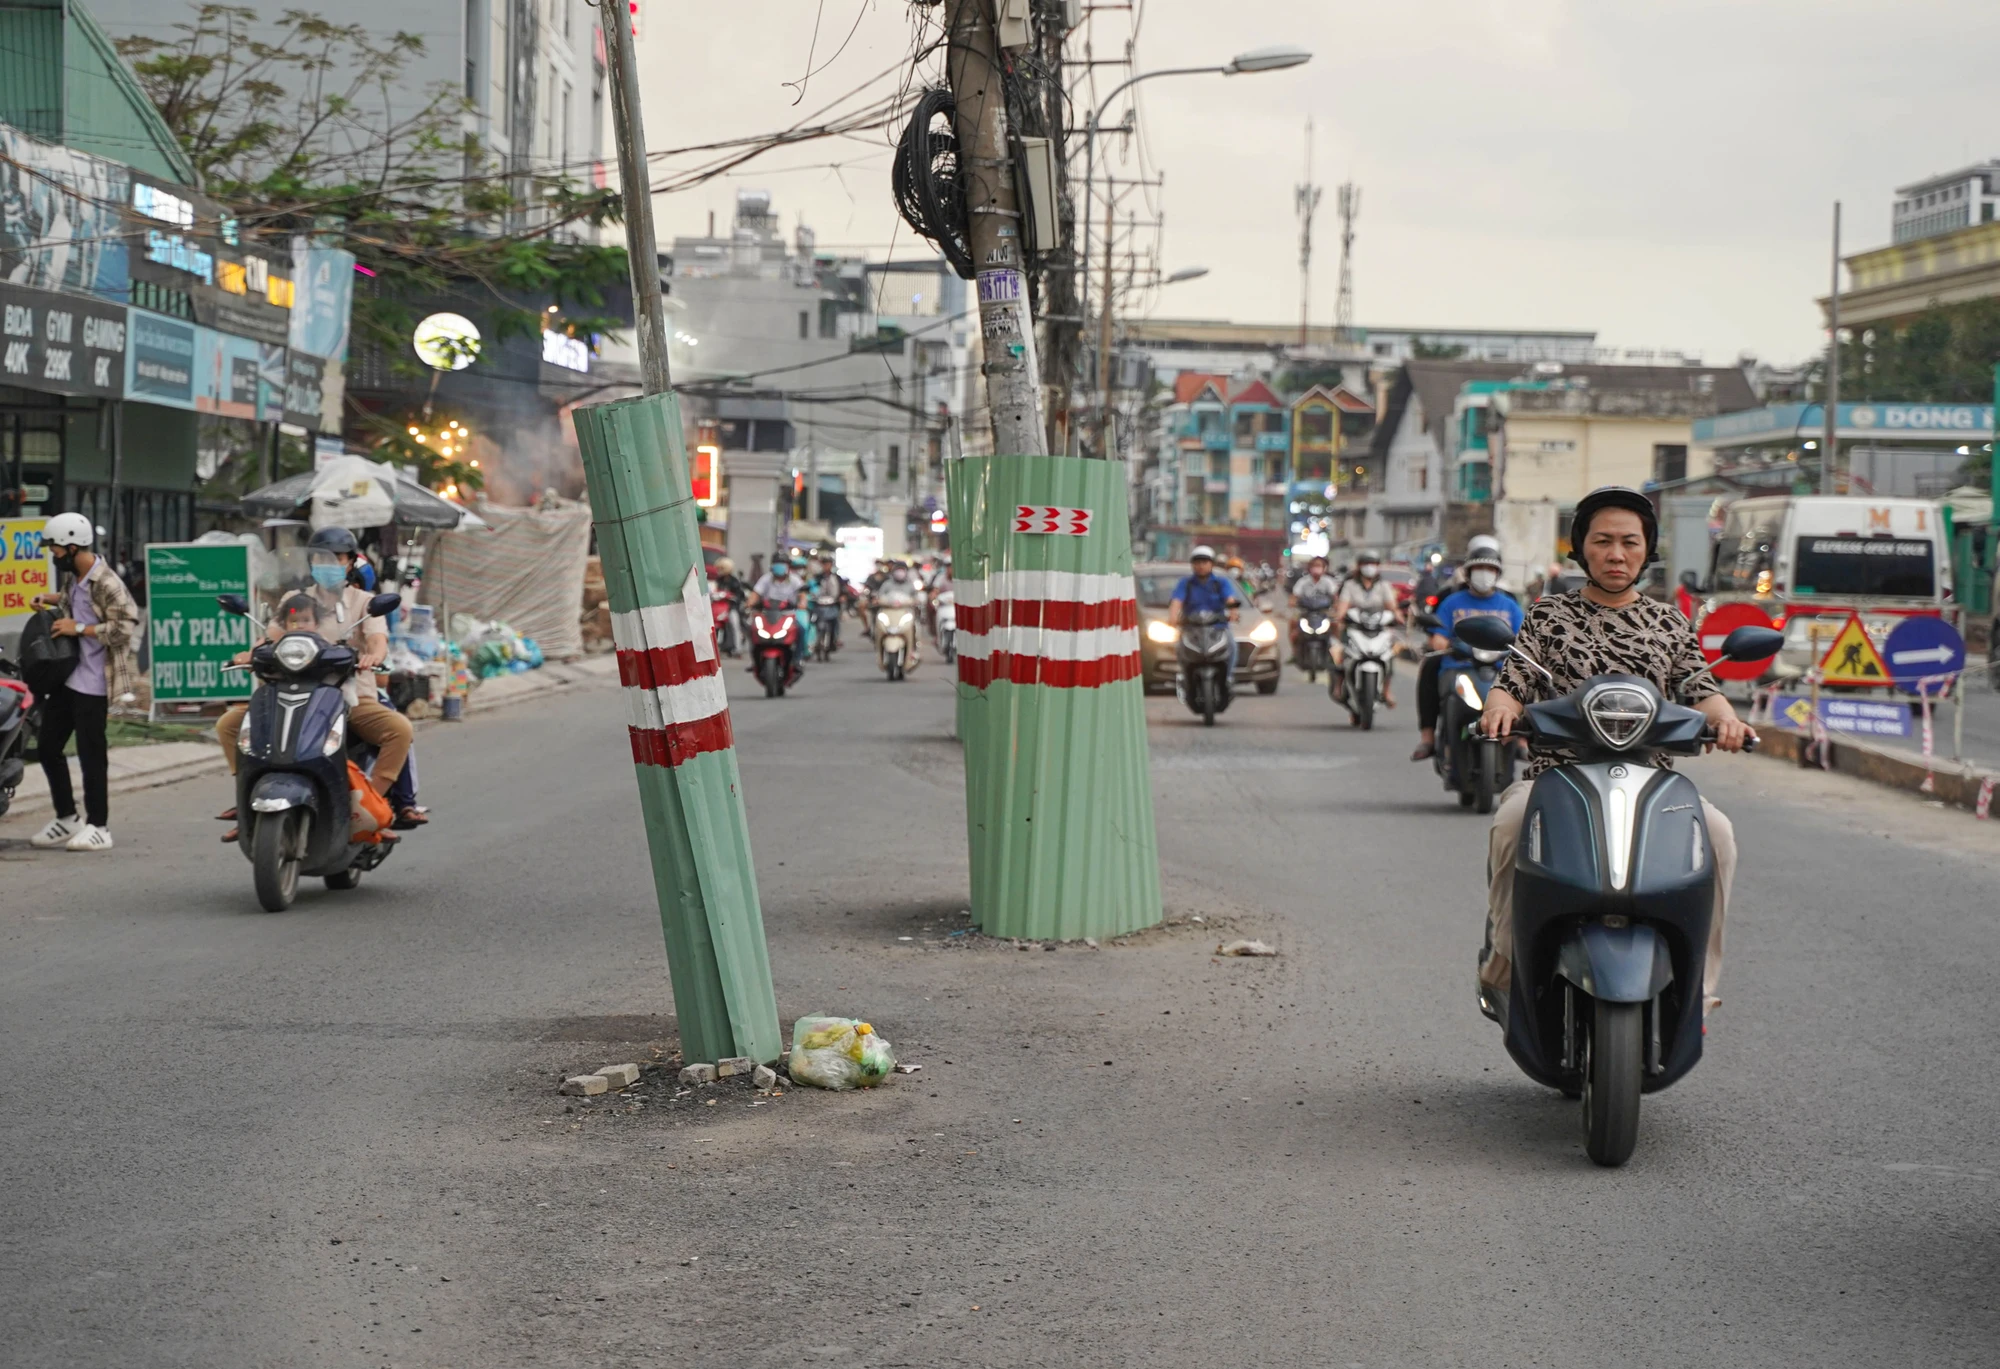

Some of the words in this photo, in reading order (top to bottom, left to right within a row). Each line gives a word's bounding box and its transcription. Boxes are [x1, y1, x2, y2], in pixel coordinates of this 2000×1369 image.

[4, 304, 33, 337] BIDA
[46, 310, 73, 343] GYM
[83, 316, 125, 352] GAMING
[4, 341, 30, 374] 40K
[1867, 508, 1891, 529] M
[14, 531, 44, 560] 262
[153, 611, 184, 646] MỸ
[155, 661, 183, 696] PHỤ
